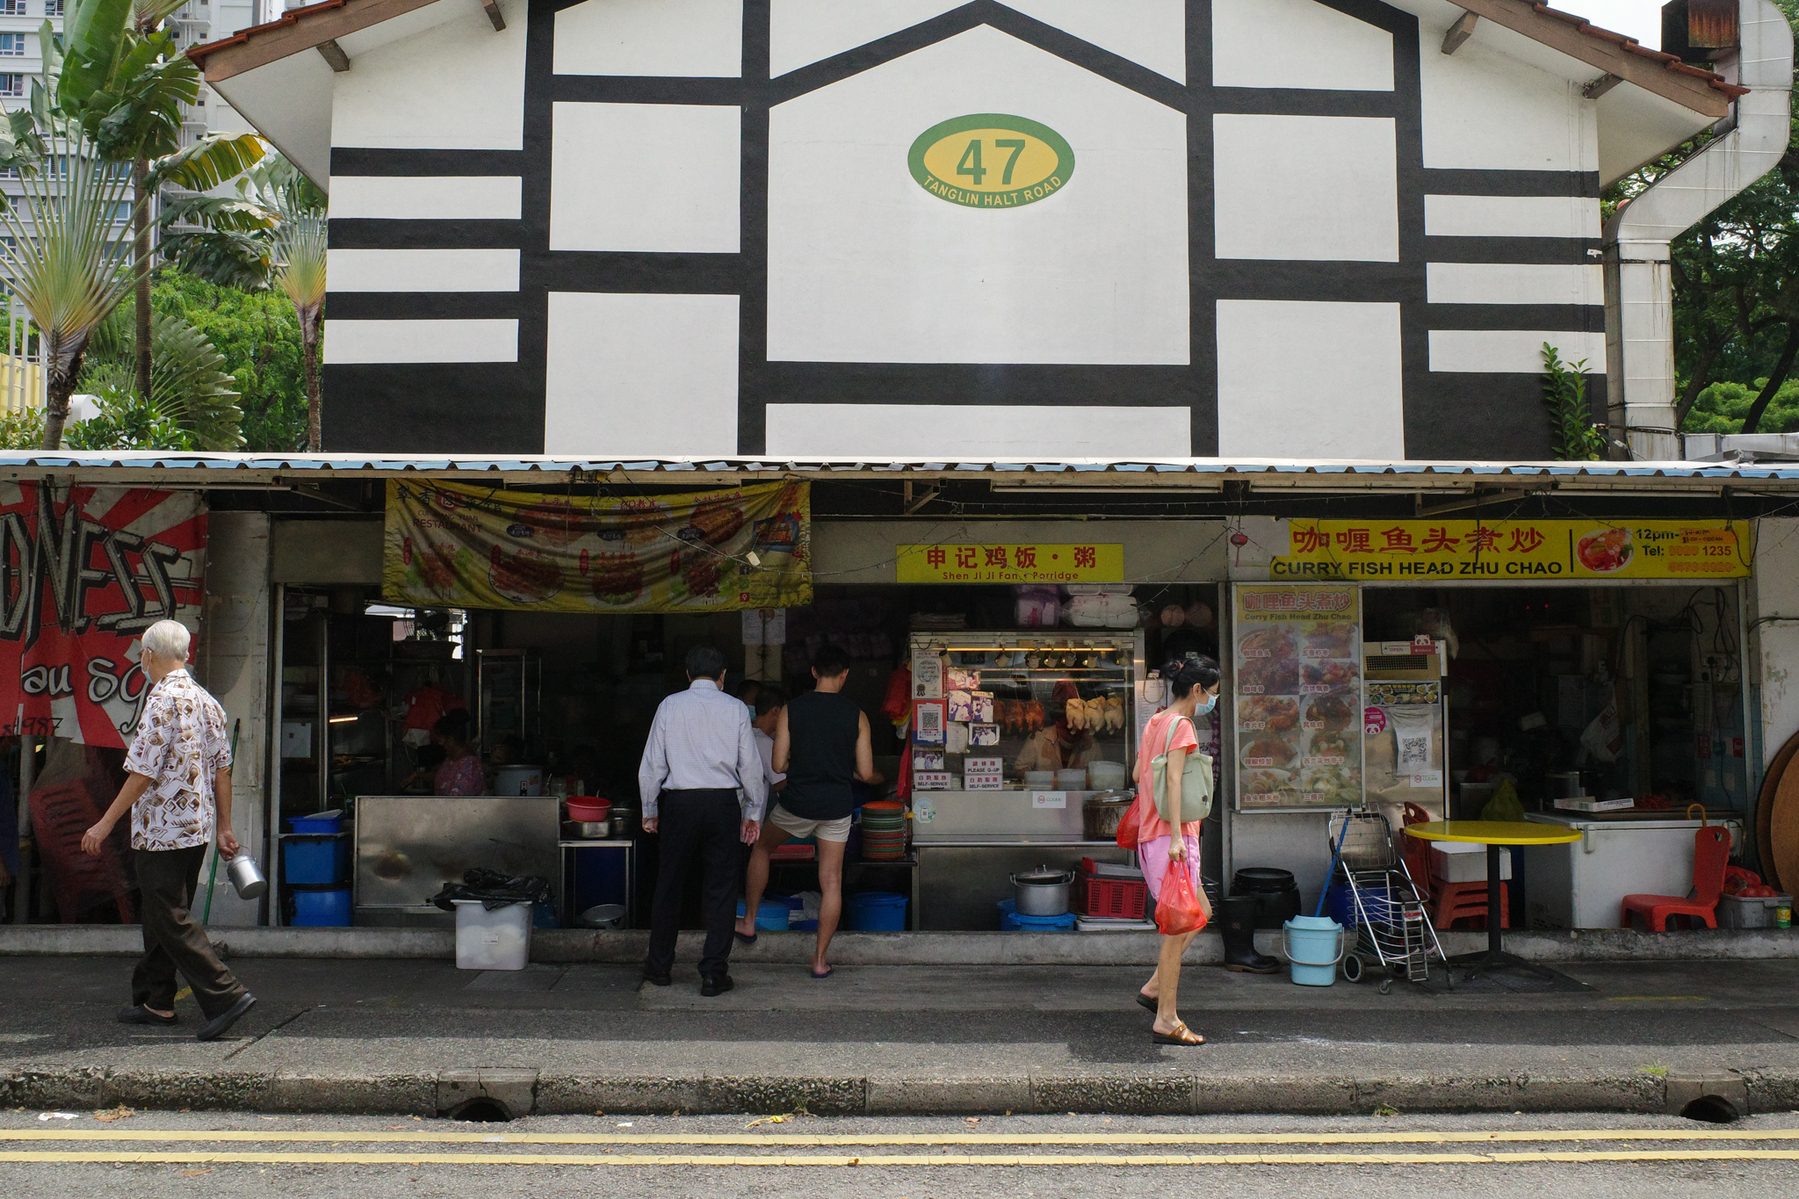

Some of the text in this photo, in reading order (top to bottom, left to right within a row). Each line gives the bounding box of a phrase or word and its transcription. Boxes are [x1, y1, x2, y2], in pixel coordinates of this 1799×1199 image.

[956, 139, 1026, 186] 47
[924, 175, 1062, 206] TANGLIN HALT ROAD
[413, 518, 483, 533] RESTAURANT
[1642, 546, 1664, 557] Tel:
[1703, 546, 1732, 556] 1235
[1273, 562, 1563, 575] CURRY FISH HEAD ZHU CHAO
[943, 571, 1079, 581] Shen Ji Ji Fan Porridge
